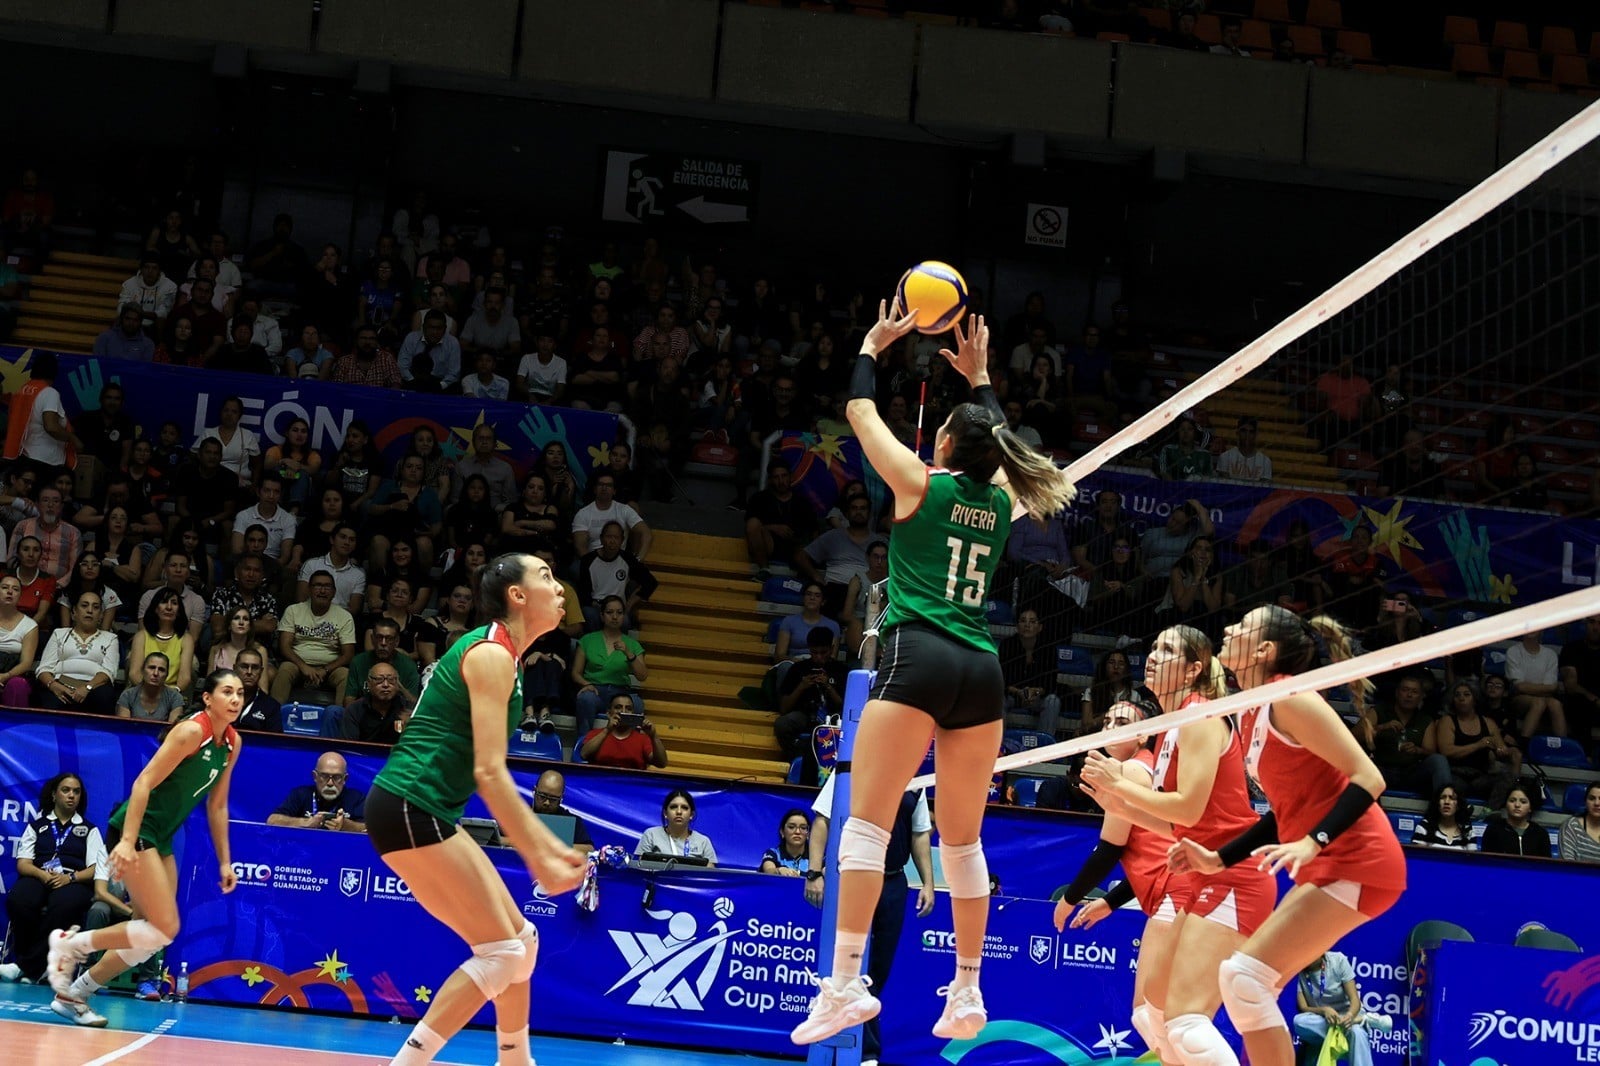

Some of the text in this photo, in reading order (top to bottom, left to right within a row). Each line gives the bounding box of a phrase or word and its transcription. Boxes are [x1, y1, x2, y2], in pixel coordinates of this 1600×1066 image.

[682, 158, 743, 176] SALIDA DE
[672, 171, 750, 191] EMERGENCIA
[194, 390, 354, 452] LEÓN
[950, 503, 998, 532] RIVERA
[945, 536, 992, 608] 15
[193, 768, 219, 798] 7
[231, 862, 271, 881] GTO
[273, 873, 287, 881] DEL
[289, 875, 317, 884] ESTADO
[274, 865, 312, 875] GOBIERNO
[272, 881, 321, 892] GUANAJUATO
[524, 904, 556, 915] FMVB
[746, 918, 815, 942] Senior
[732, 940, 816, 963] NORCECA
[1063, 941, 1116, 964] LEÓN
[728, 959, 768, 982] Pan
[724, 985, 775, 1013] Cup
[780, 991, 807, 1003] Leon
